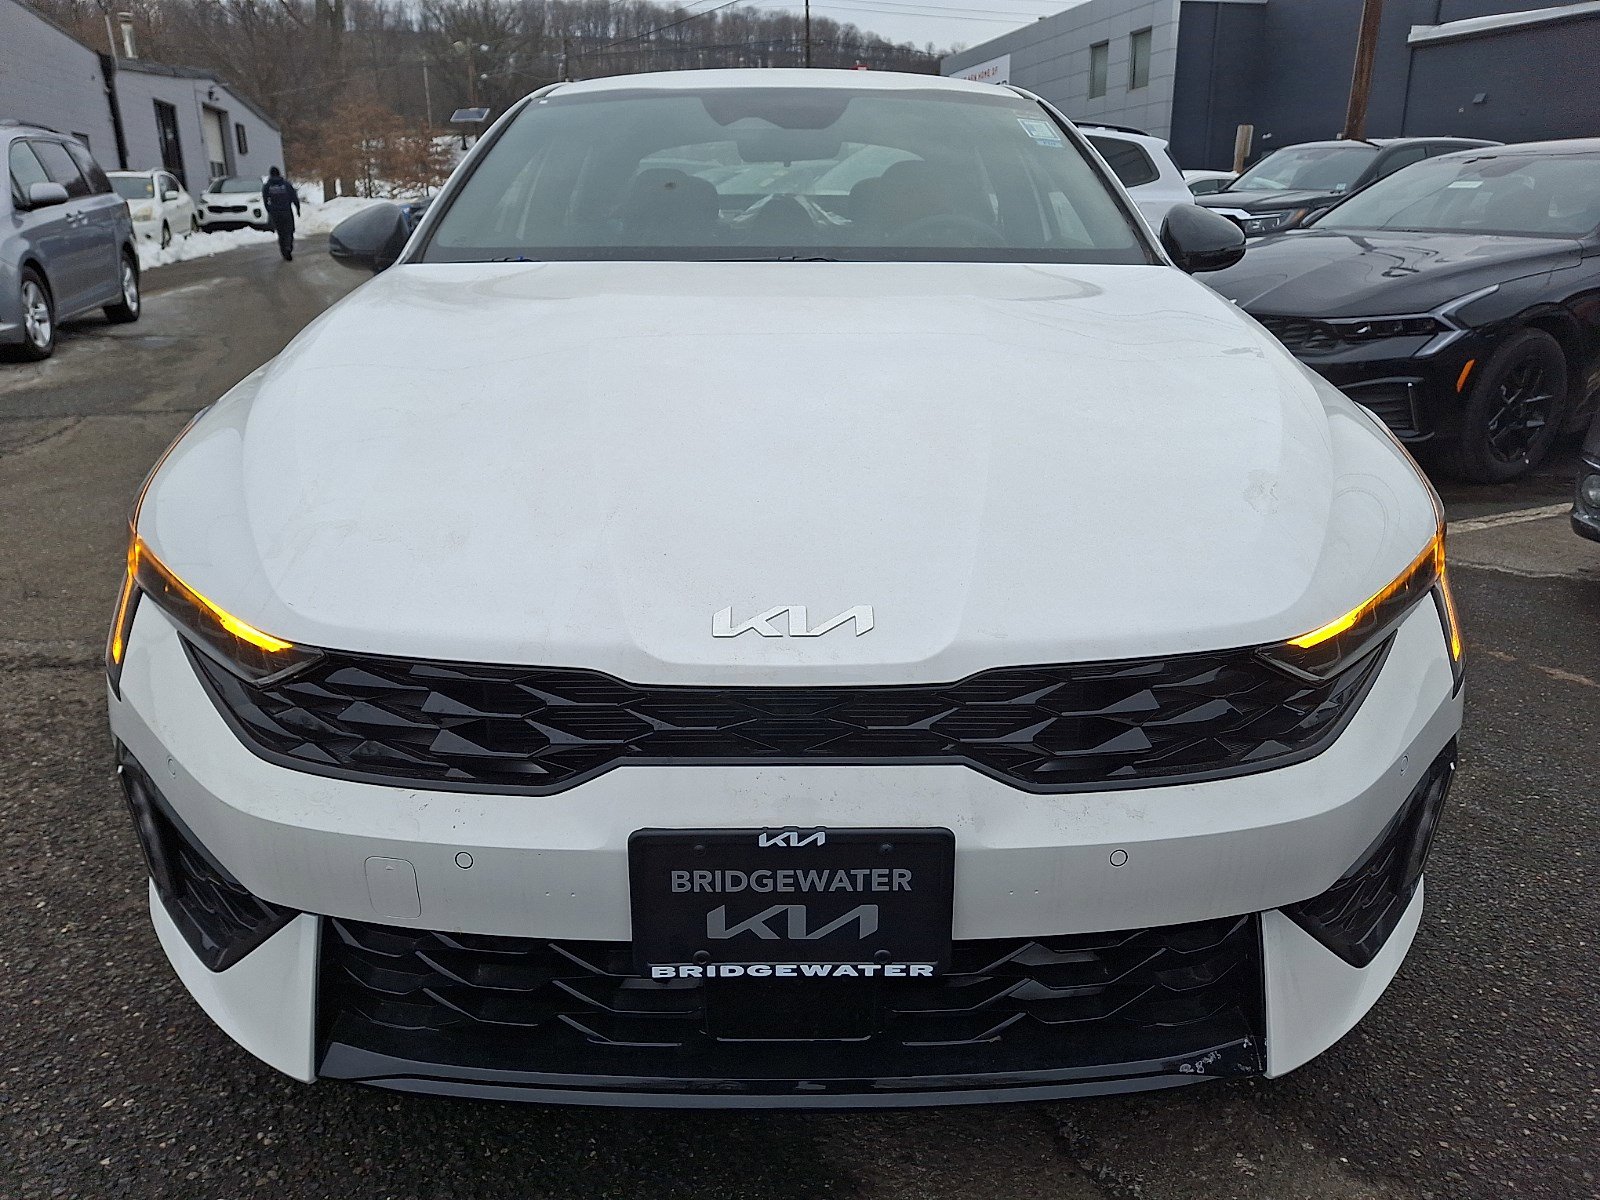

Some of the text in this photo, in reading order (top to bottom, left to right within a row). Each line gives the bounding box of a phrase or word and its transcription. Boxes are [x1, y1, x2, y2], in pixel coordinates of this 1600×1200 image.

[712, 605, 874, 638] KIA
[759, 831, 826, 847] KIA
[671, 868, 912, 893] BRIDGEWATER
[706, 904, 879, 940] KIA
[651, 964, 934, 978] BRIDGEWATER
